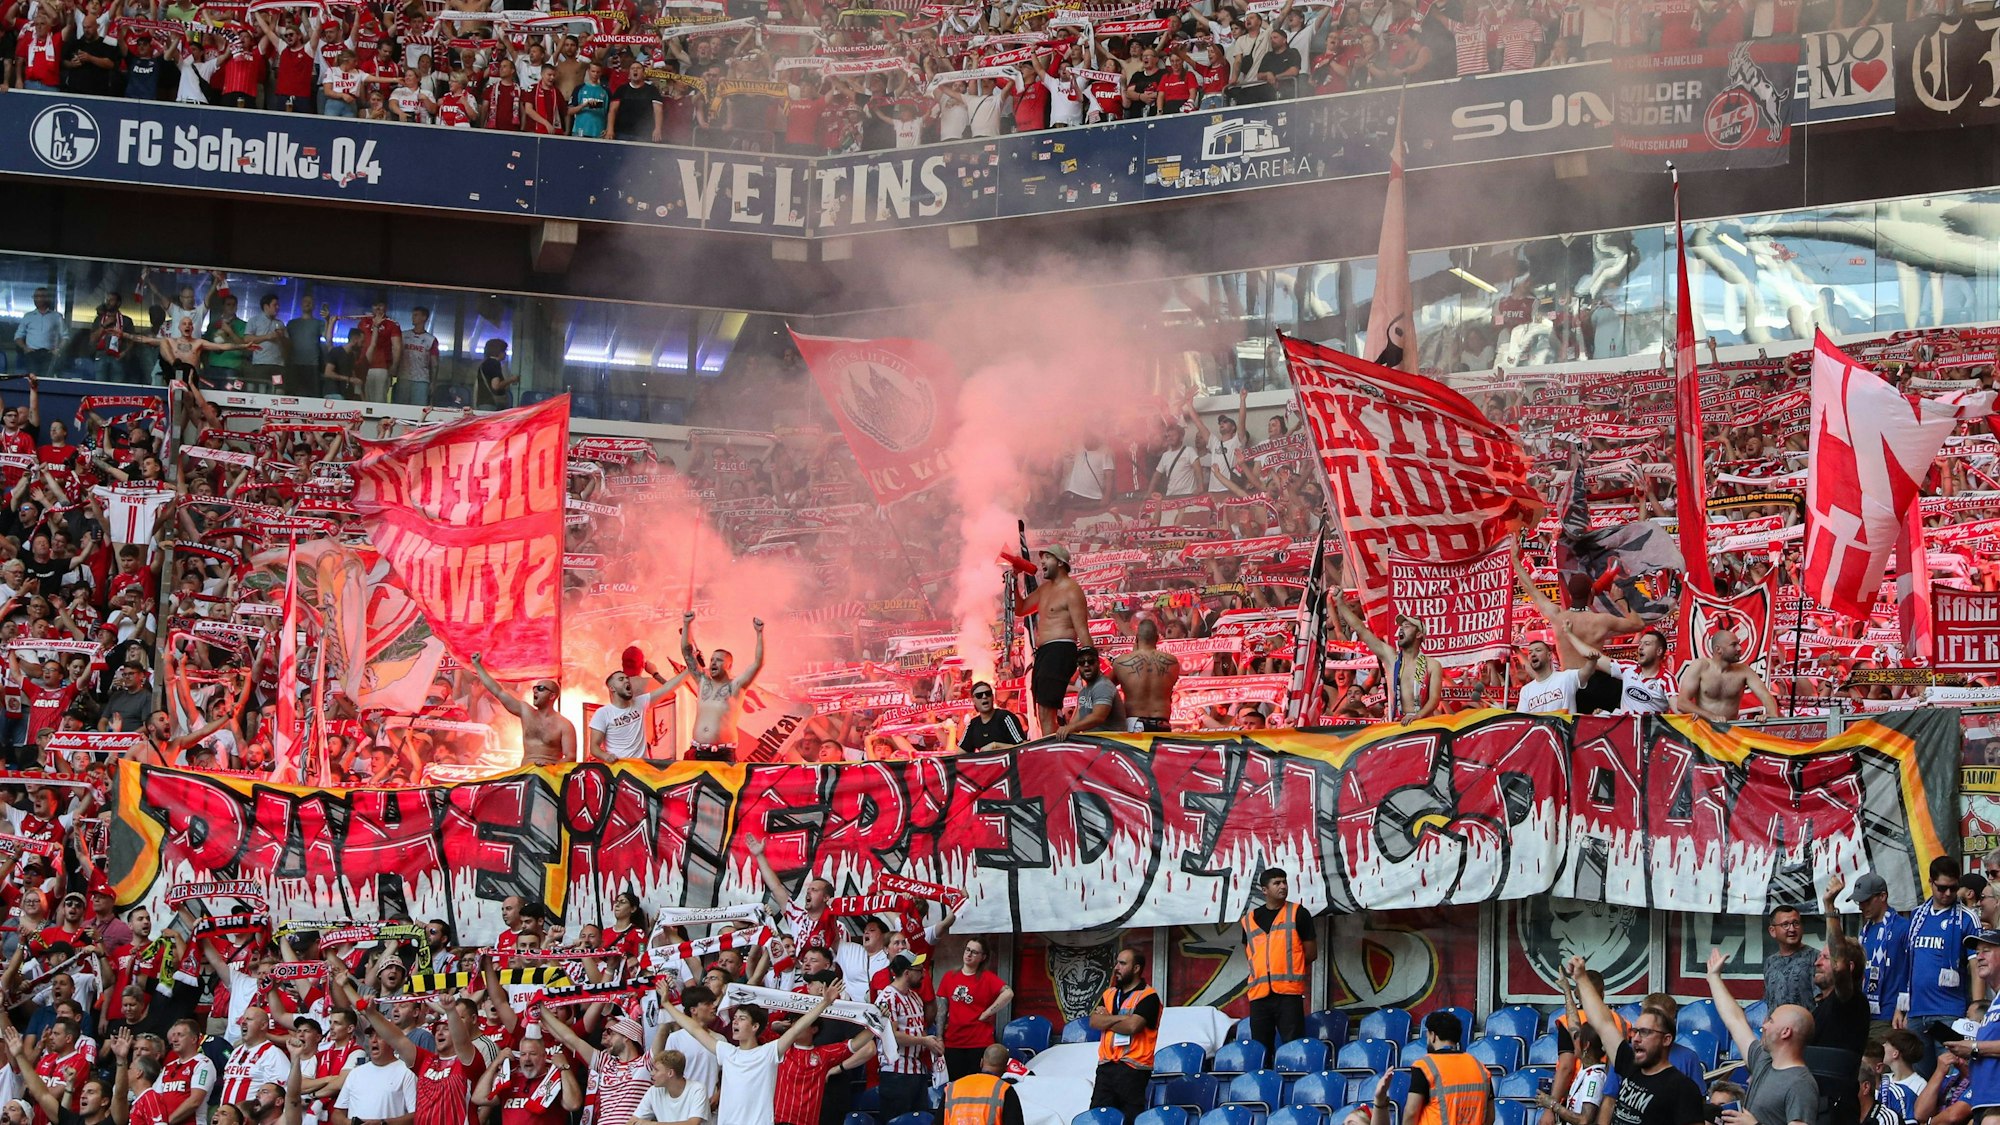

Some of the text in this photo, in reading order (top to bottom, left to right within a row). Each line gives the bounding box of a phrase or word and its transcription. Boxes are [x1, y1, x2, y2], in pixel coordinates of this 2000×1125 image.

[1079, 69, 1090, 79] FC
[1719, 124, 1742, 140] KÖLN
[118, 119, 381, 188] FC Schalke 04
[677, 155, 947, 228] VELTINS
[1647, 381, 1669, 391] SIND
[1718, 391, 1738, 403] DER
[1569, 416, 1582, 425] FC
[1583, 412, 1609, 423] KÖLN
[598, 452, 629, 465] KÖLN
[120, 496, 147, 505] REWE
[579, 502, 591, 510] FC
[1707, 493, 1794, 507] Borussia Dortmund
[1392, 554, 1510, 579] DIE WAHRE GRÖSSE
[1393, 568, 1510, 599] EINER KURVE
[1393, 589, 1508, 617] WIRD AN DER
[1394, 608, 1506, 637] HL IHRER
[1213, 636, 1234, 649] Köln
[1448, 628, 1504, 650] BEMESSEN!
[1937, 635, 1980, 662] 1.FC
[33, 699, 60, 708] REWE
[191, 885, 215, 895] SIND
[217, 883, 236, 894] DIE
[841, 898, 857, 912] FC
[215, 915, 243, 926] BIN
[764, 999, 807, 1010] BORUSSIA
[226, 1066, 251, 1076] REWE
